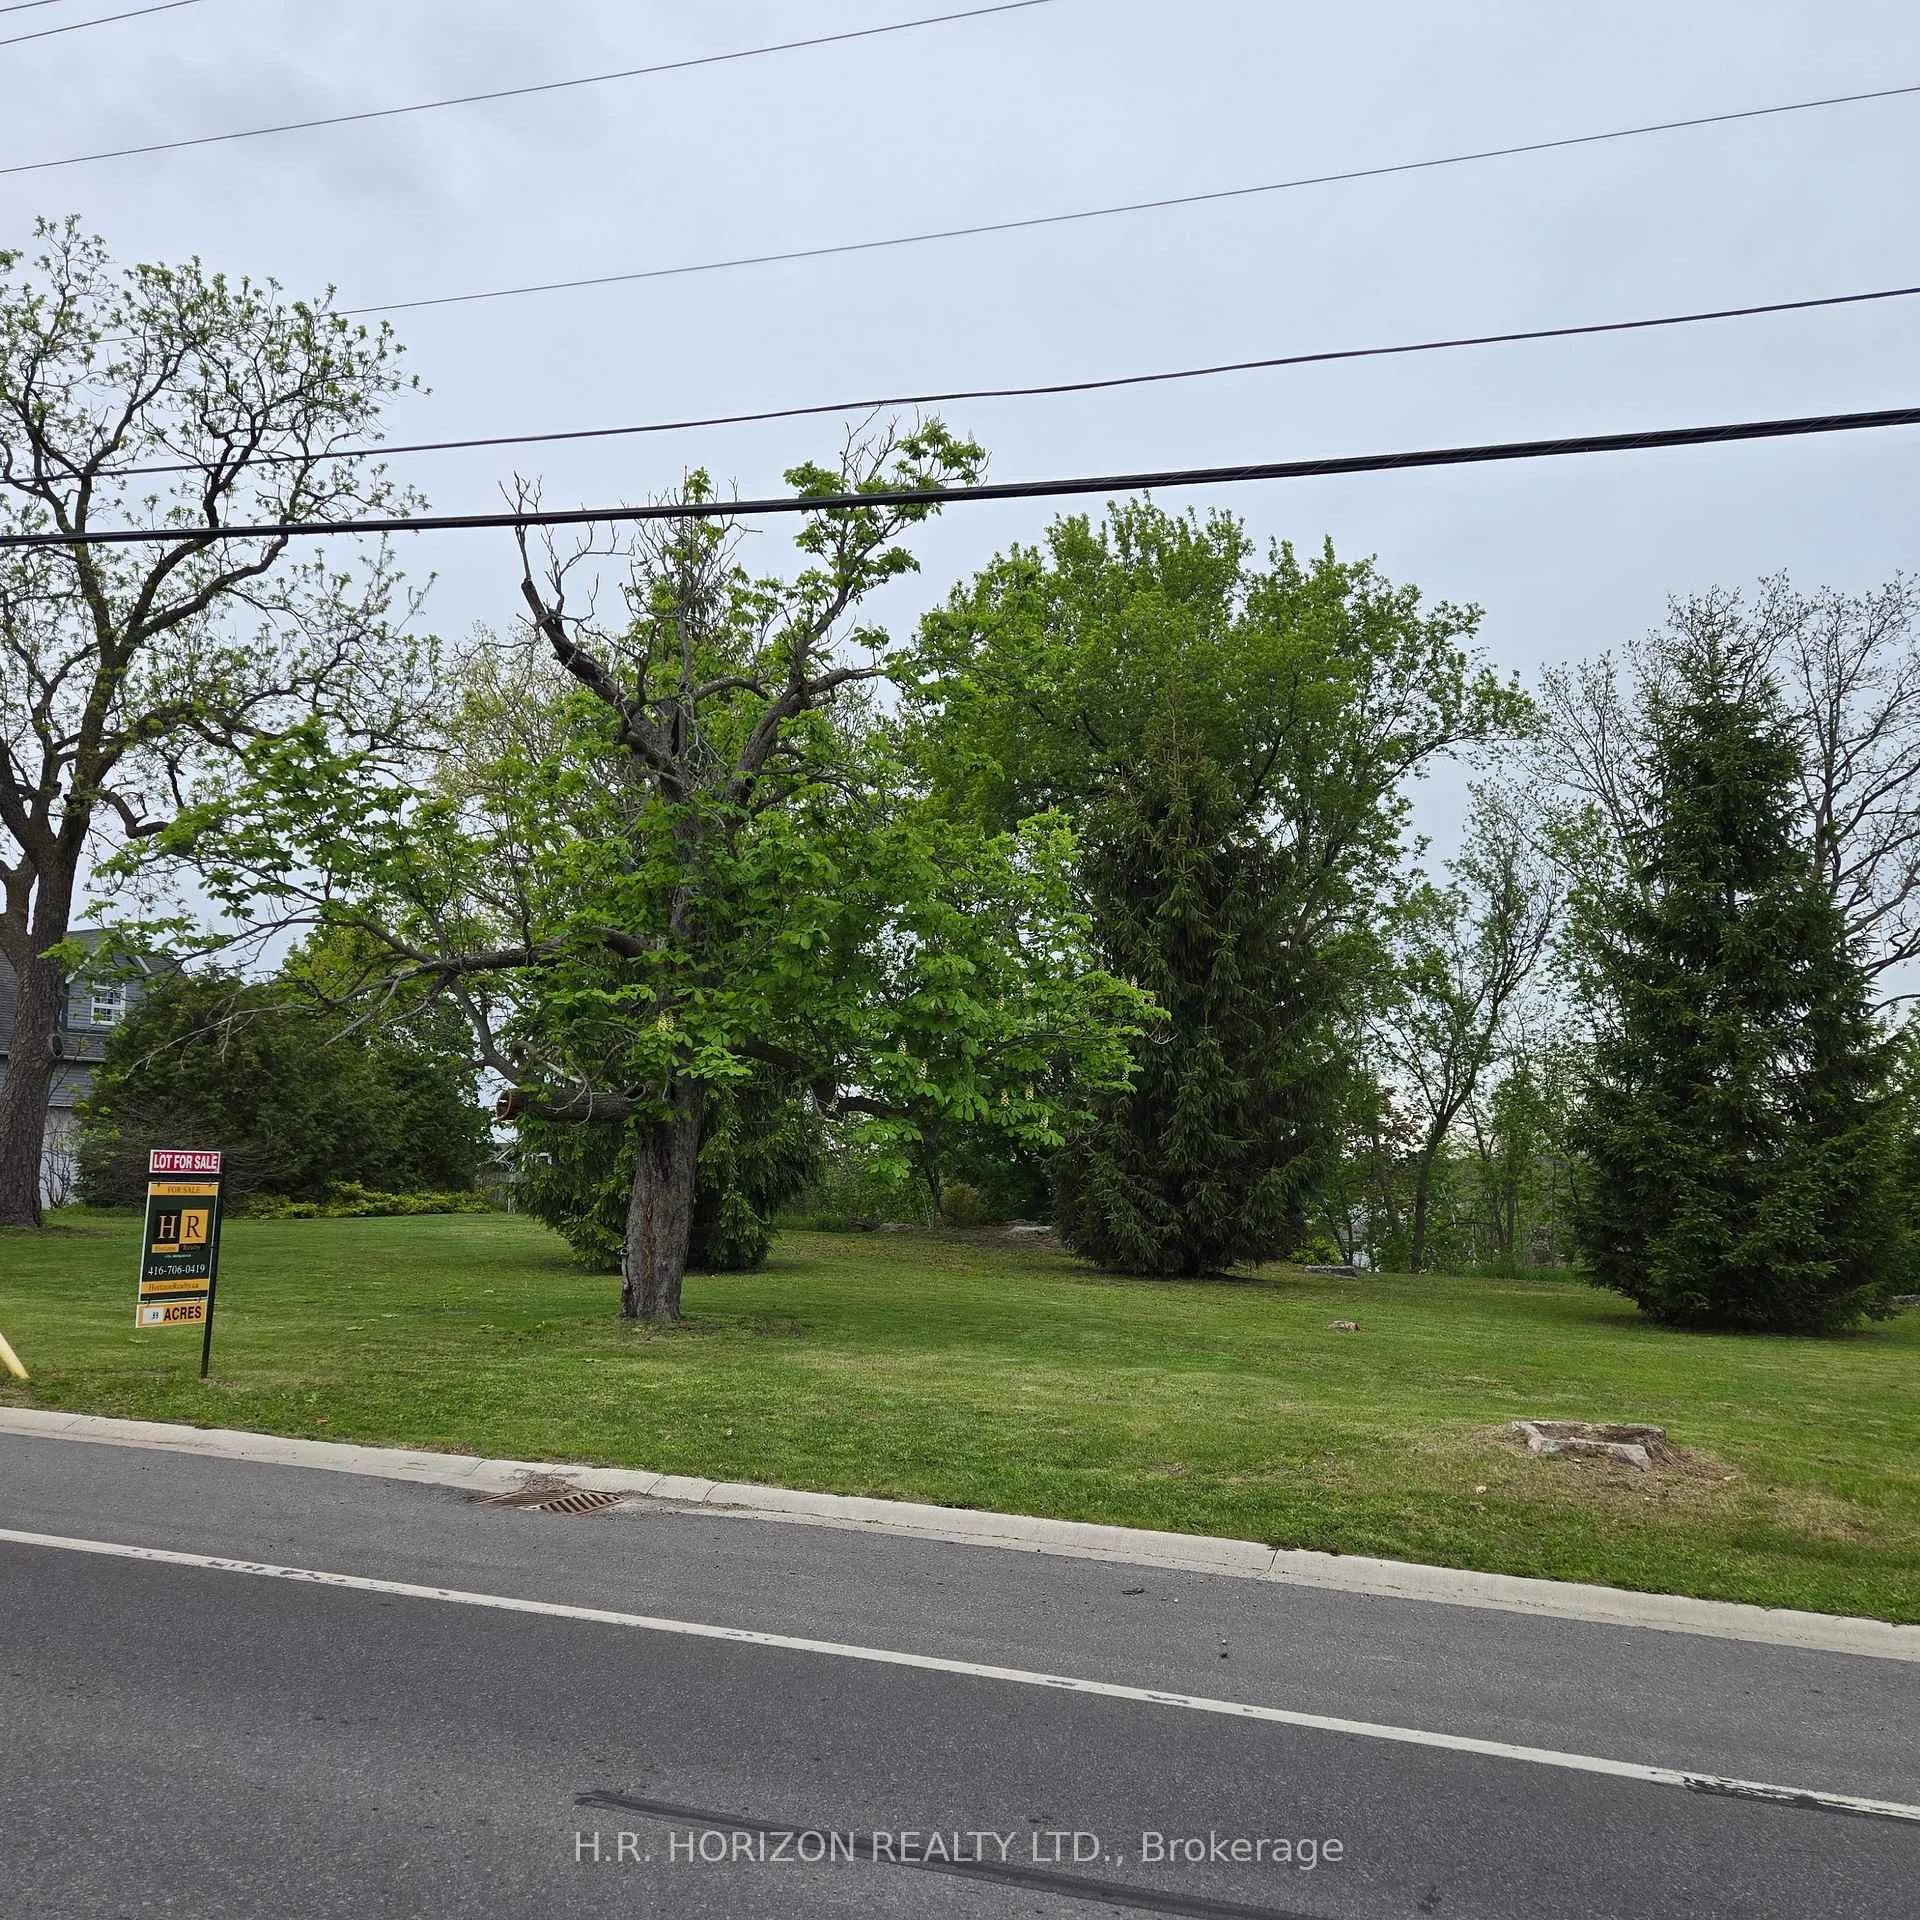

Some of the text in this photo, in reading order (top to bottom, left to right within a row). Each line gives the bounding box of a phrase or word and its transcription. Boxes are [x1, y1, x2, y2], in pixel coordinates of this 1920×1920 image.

[153, 1154, 218, 1169] LOT FOR SALE
[148, 1263, 206, 1276] 416-706-0419
[163, 1305, 202, 1321] ACRES
